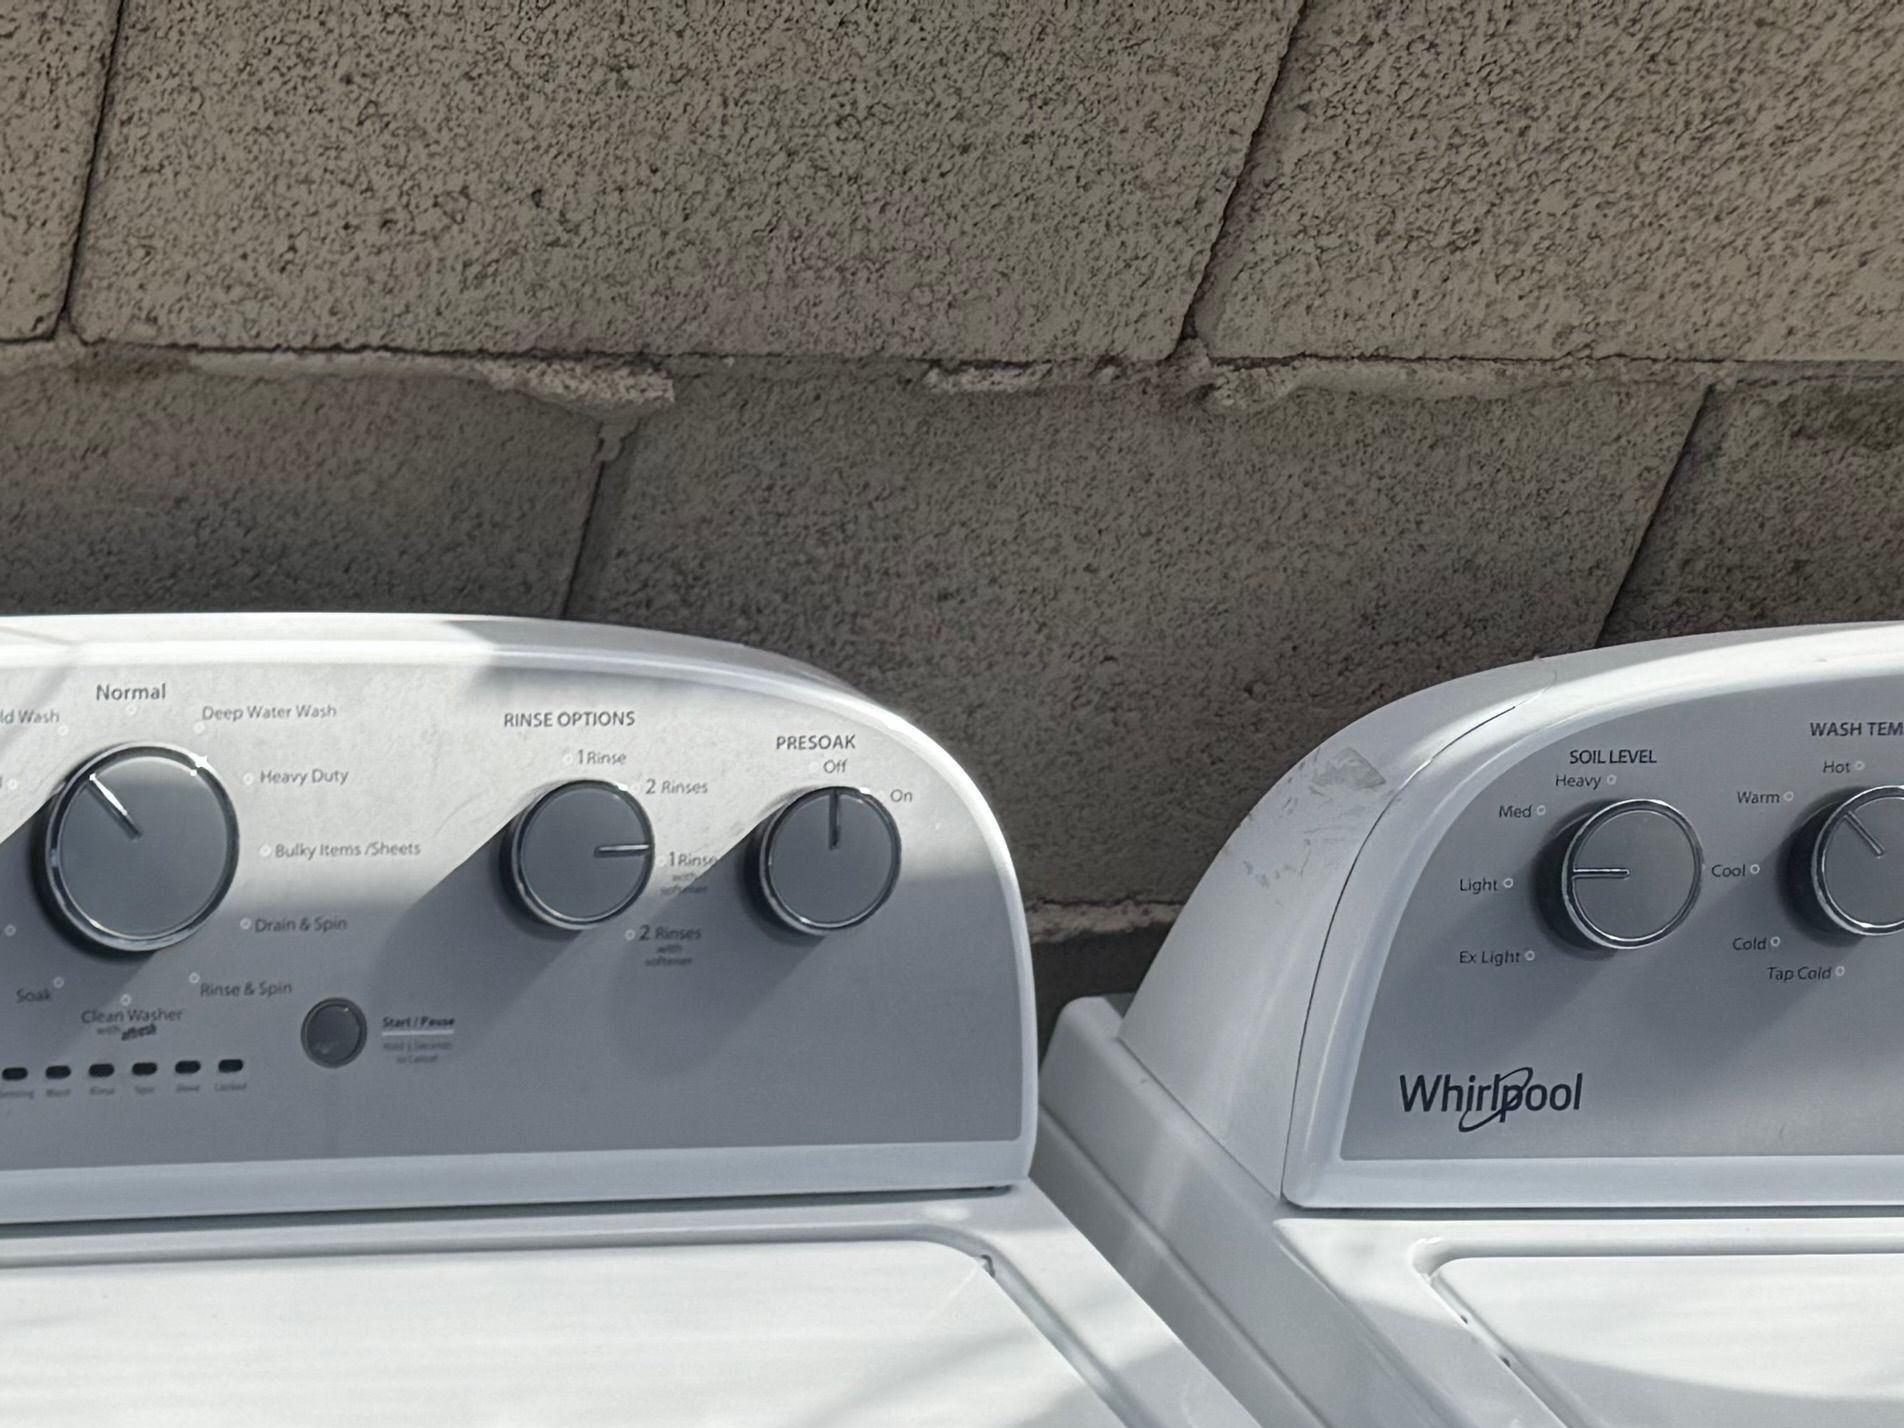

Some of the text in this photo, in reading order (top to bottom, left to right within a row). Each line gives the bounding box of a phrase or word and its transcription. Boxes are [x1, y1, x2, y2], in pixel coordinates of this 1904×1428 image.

[95, 683, 167, 701] Normal
[18, 709, 60, 724] Wash
[202, 705, 337, 722] Deep Water Wash
[504, 711, 636, 727] RINSE OPTIONS
[1810, 722, 1862, 737] WASH
[776, 734, 856, 751] PRESOAK
[577, 749, 627, 765] 1 Rinse
[1569, 749, 1657, 764] SOIL LEVEL
[823, 758, 848, 774] Off
[1823, 760, 1851, 774] Hot
[260, 769, 349, 786] Heavy Duty
[1555, 774, 1601, 790] Heavy
[645, 778, 709, 794] 2 Rinses
[890, 788, 913, 803] On
[1737, 791, 1780, 804] Warm
[1498, 805, 1532, 818] Med
[275, 844, 317, 860] Bulky
[320, 843, 361, 857] Items
[669, 851, 718, 867] 1 Rinse
[1711, 864, 1746, 877] Cool
[1460, 878, 1498, 894] Light
[255, 916, 348, 933] Drain & Spin
[639, 924, 703, 941] 2 Rinses
[1732, 937, 1767, 951] Cold
[1459, 951, 1520, 966] Ex Light
[1768, 966, 1832, 982] Tap Cold
[16, 988, 52, 1004] Soak
[200, 980, 293, 998] Rinse & Spin
[81, 1007, 183, 1024] Clean Washer
[1399, 1066, 1583, 1133] Whirlpool
